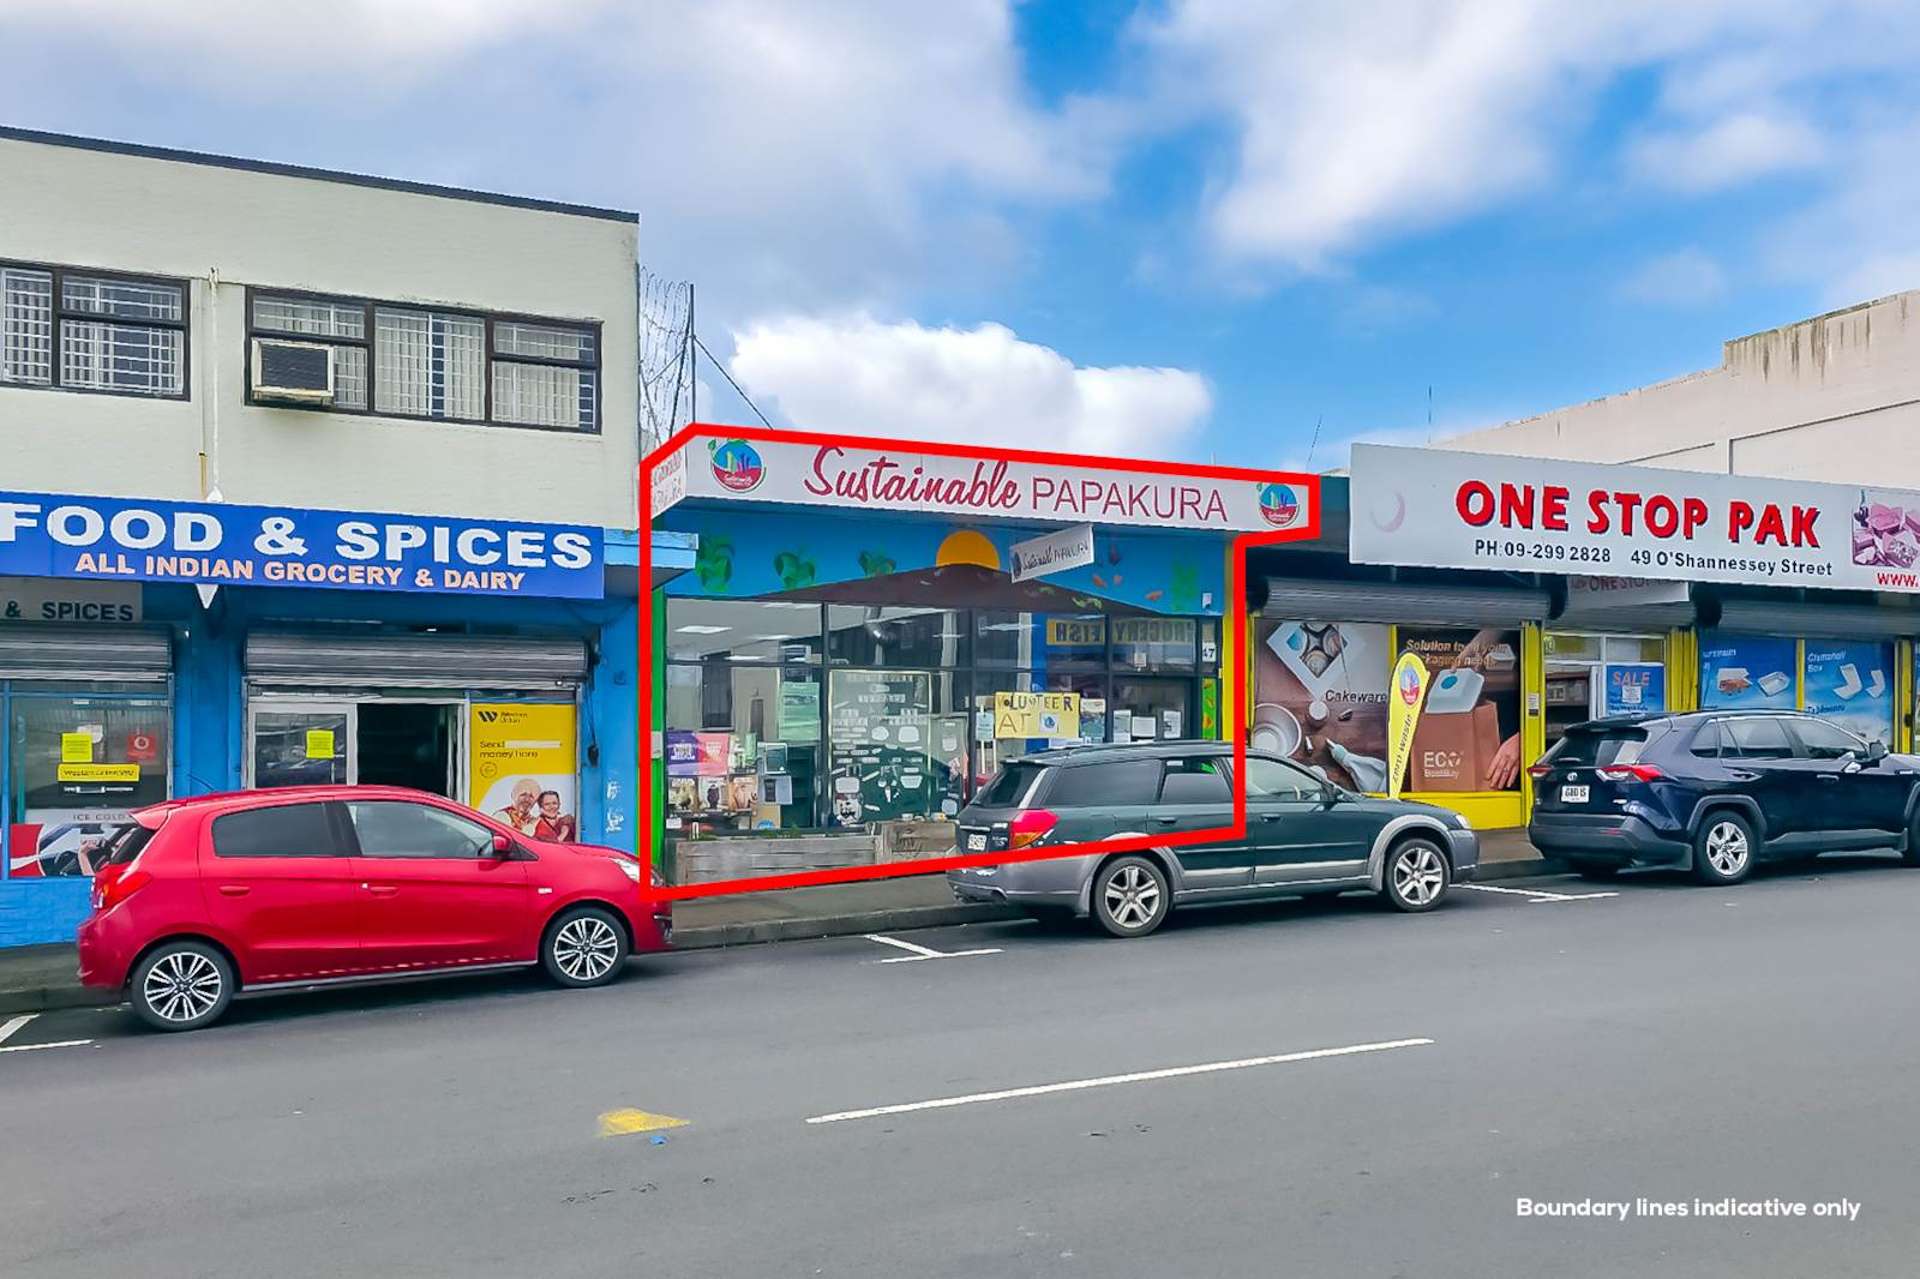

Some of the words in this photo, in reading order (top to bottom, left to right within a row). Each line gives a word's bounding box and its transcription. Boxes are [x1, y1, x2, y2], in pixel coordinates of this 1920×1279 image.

[804, 446, 1021, 509] Sustainable
[1032, 476, 1228, 522] PAPAKURA
[1455, 479, 1570, 531] ONE
[1586, 489, 1709, 540] STOP
[1727, 500, 1821, 549] PAK
[0, 501, 224, 552] FOOD
[253, 516, 309, 556] &
[335, 521, 593, 569] SPICES
[1569, 543, 1612, 563] 2828
[1630, 549, 1652, 566] 49
[1656, 551, 1777, 577] O'Shannessey
[1780, 558, 1833, 577] Street
[74, 552, 137, 575] ALL
[145, 556, 254, 580] INDIAN
[263, 561, 403, 586] GROCERY
[414, 569, 435, 589] &
[444, 569, 526, 591] DAIRY
[5, 600, 22, 618] &
[41, 602, 134, 622] SPICES
[1406, 640, 1452, 653] Solution
[1612, 671, 1651, 687] SALE
[1325, 689, 1387, 705] Cakeware
[1423, 751, 1461, 768] ECO
